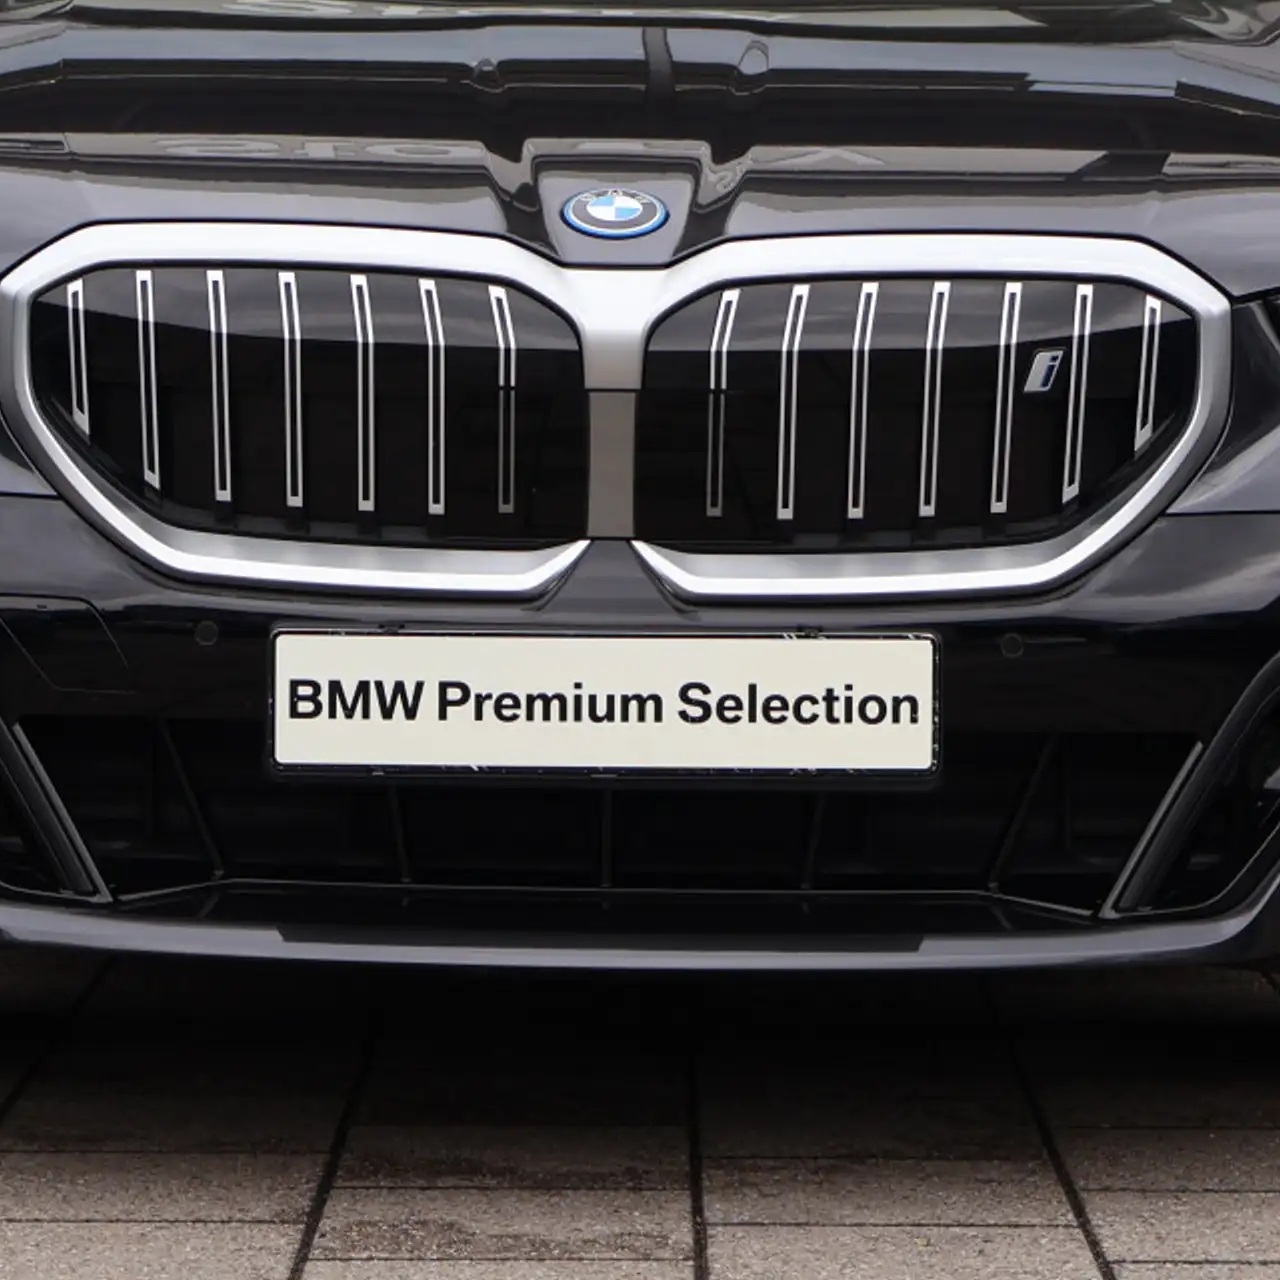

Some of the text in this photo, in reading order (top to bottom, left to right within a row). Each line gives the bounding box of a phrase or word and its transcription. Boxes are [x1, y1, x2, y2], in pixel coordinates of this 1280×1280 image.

[289, 680, 919, 726] BMW Premium Selection
